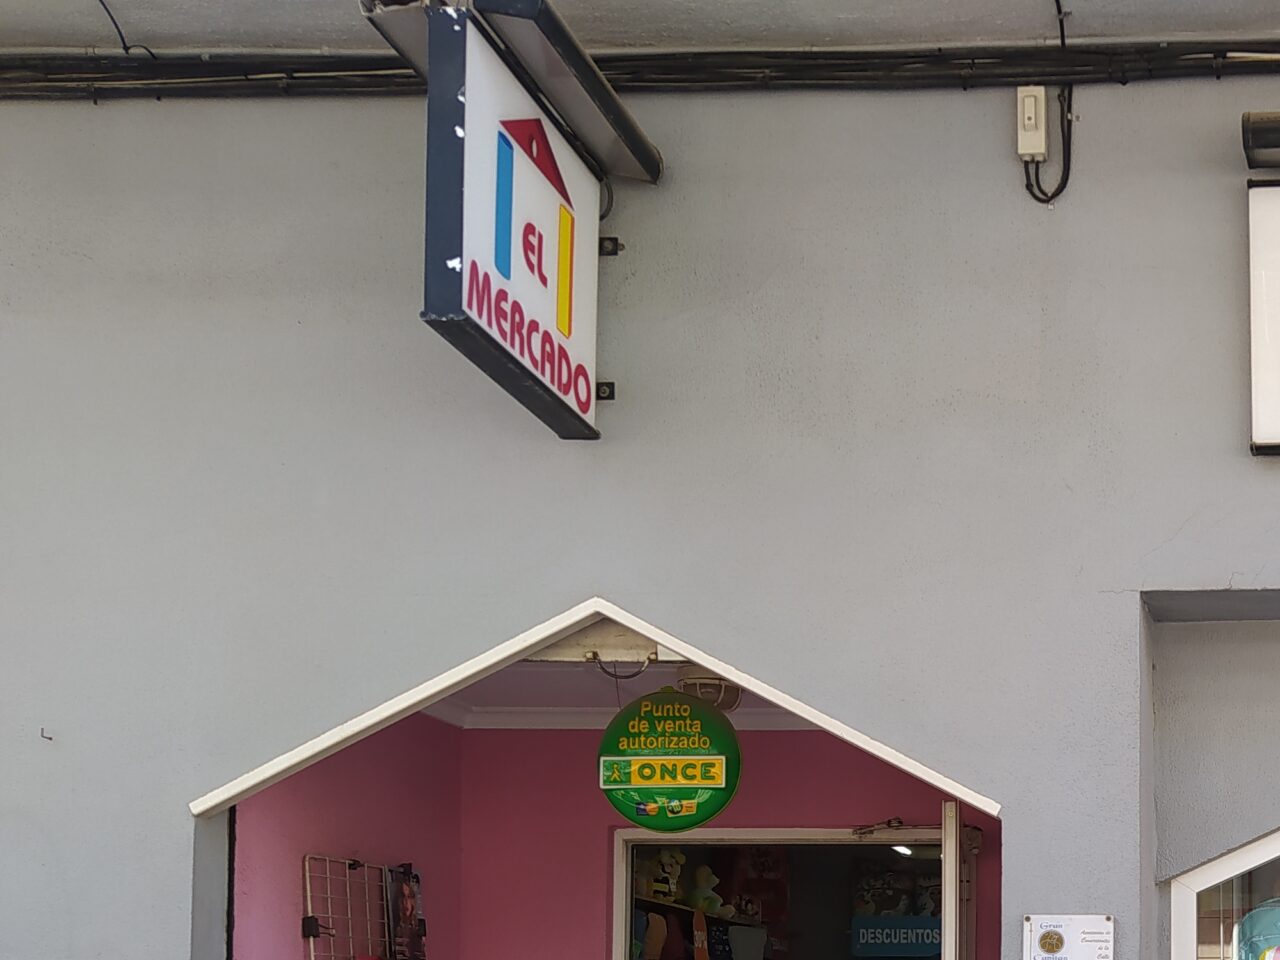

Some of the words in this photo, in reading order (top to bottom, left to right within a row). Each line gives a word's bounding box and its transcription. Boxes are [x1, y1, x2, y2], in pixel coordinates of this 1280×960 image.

[522, 222, 548, 288] EL
[466, 259, 592, 415] MERCADO
[640, 701, 691, 716] Punto
[628, 717, 650, 733] de
[655, 718, 702, 732] venta
[618, 733, 710, 749] autorizado
[637, 762, 716, 780] ONCE
[859, 928, 941, 944] DESCUENTOS
